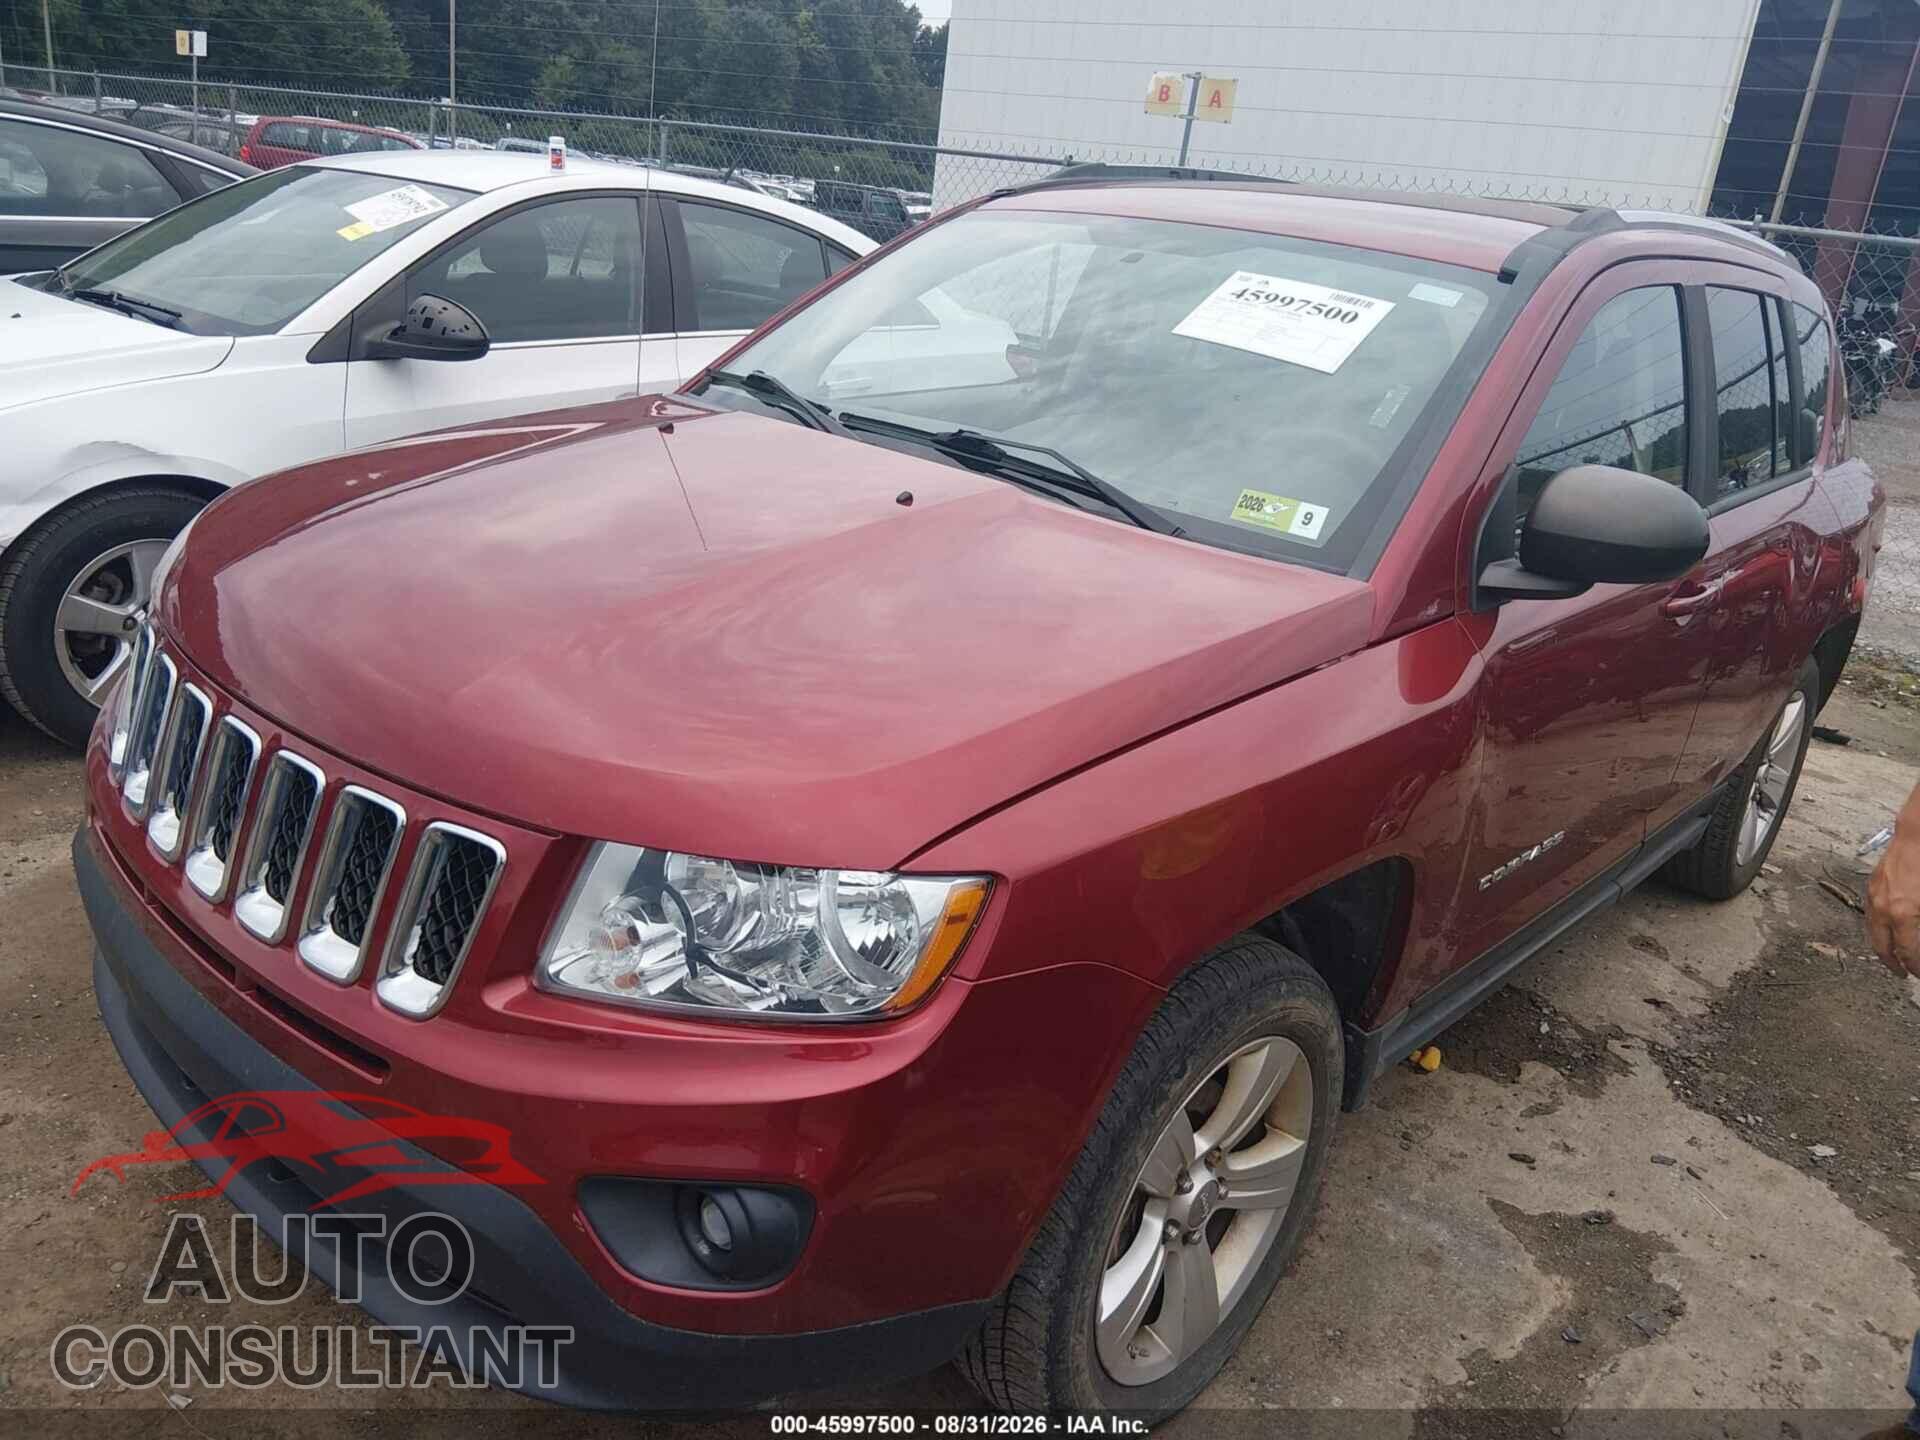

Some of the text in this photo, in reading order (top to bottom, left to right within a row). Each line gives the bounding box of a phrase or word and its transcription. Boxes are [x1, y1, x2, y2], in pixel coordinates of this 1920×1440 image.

[1158, 84, 1170, 102] B
[1208, 90, 1222, 108] A
[1231, 287, 1360, 325] 45997500
[1237, 494, 1266, 513] 2026
[1301, 512, 1314, 526] 9
